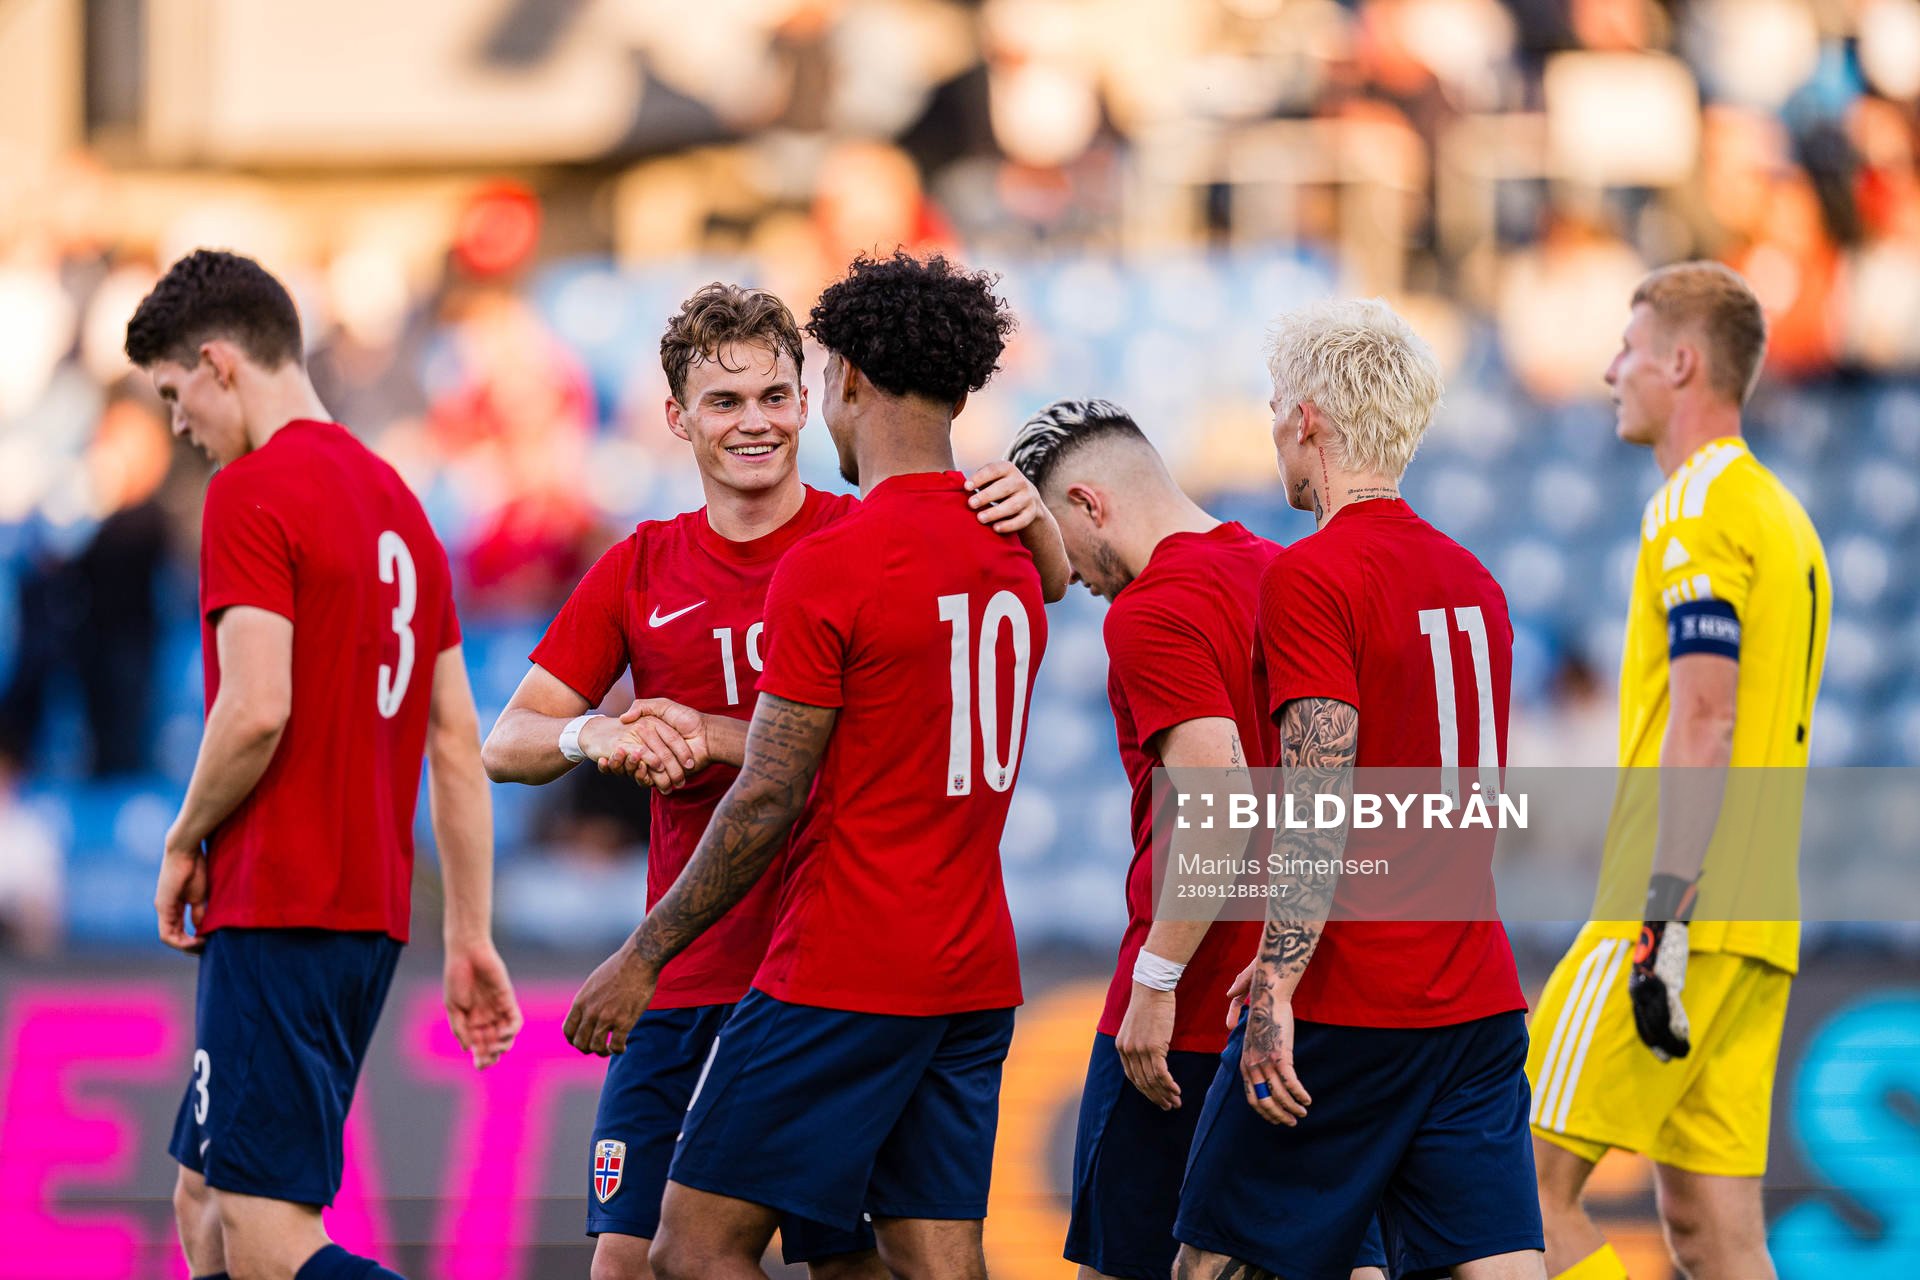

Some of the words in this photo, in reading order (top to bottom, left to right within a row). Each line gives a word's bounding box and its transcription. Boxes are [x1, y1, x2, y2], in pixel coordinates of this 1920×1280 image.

[377, 530, 418, 720] 3
[937, 589, 1031, 797] 10
[1418, 605, 1501, 810] 11
[194, 1048, 211, 1126] 3
